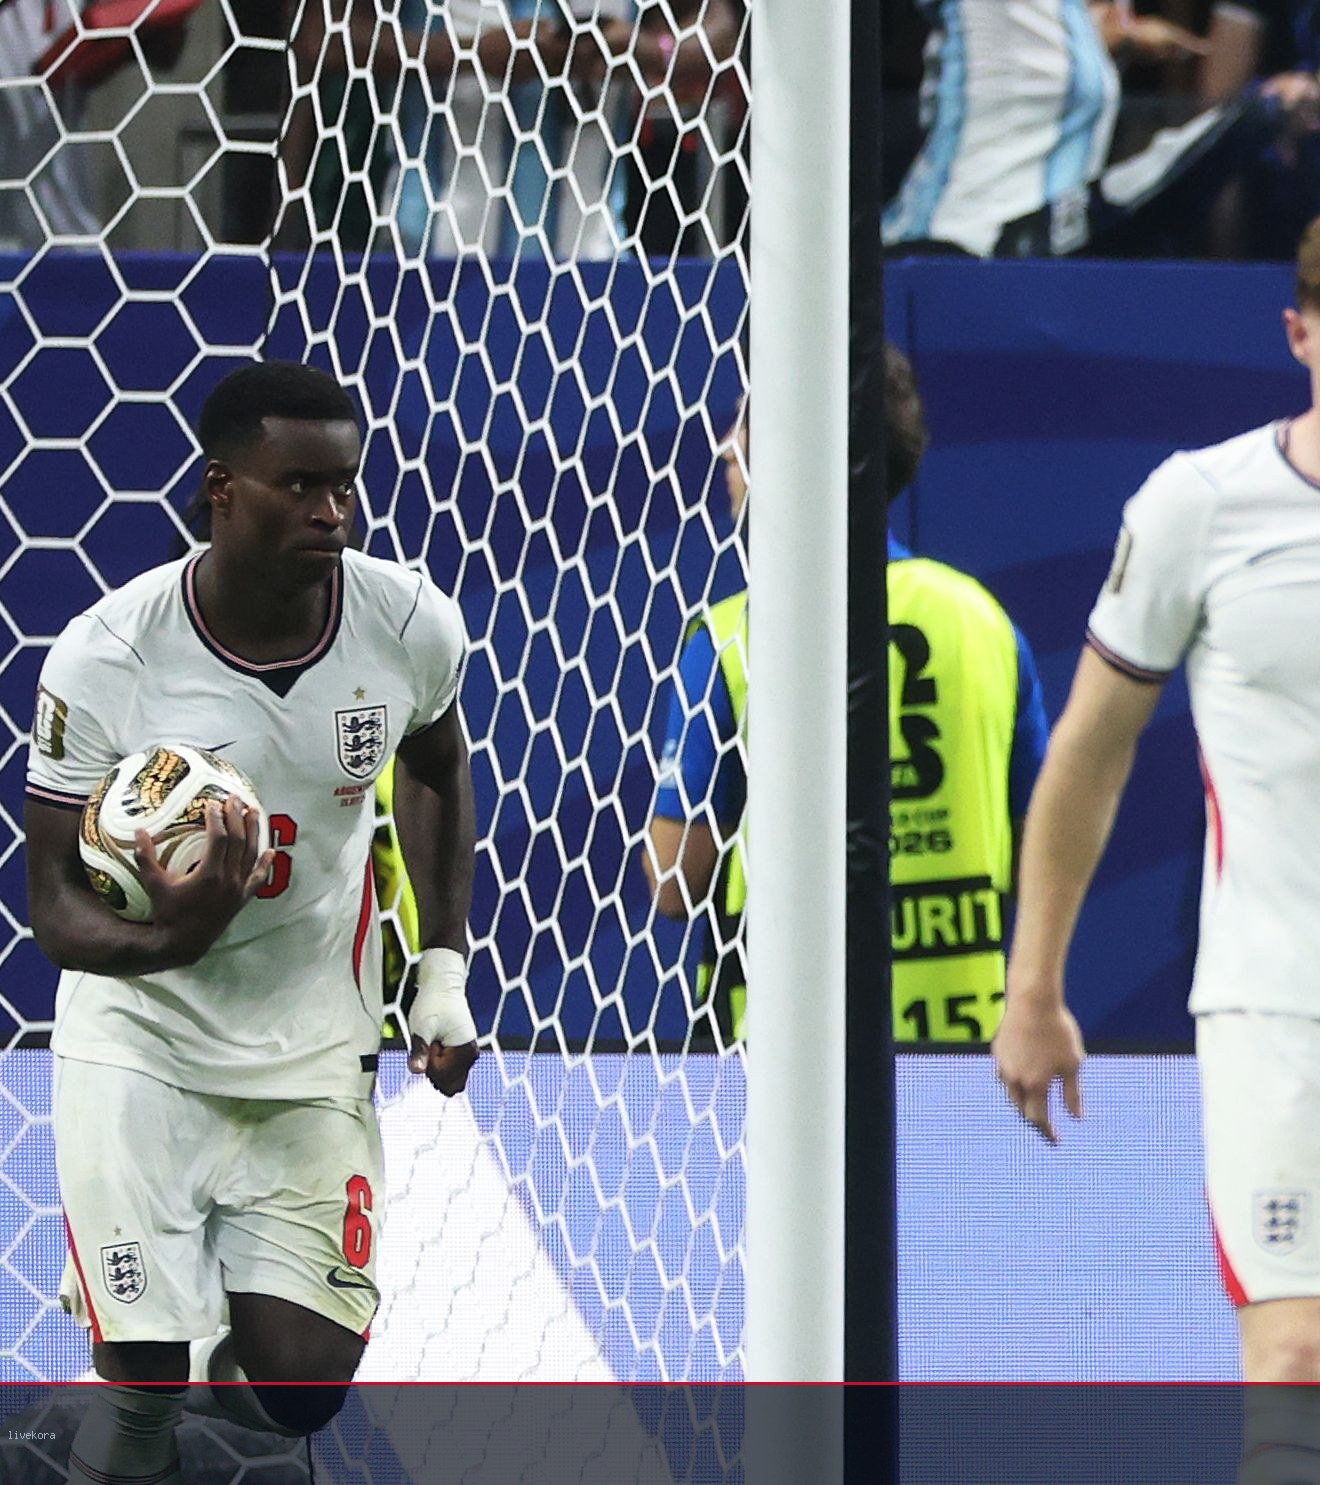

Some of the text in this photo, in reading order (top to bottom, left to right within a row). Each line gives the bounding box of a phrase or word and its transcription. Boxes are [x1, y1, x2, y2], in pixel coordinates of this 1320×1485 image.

[891, 889, 1002, 950] URIT
[902, 992, 1006, 1043] 15
[343, 1174, 373, 1269] 6
